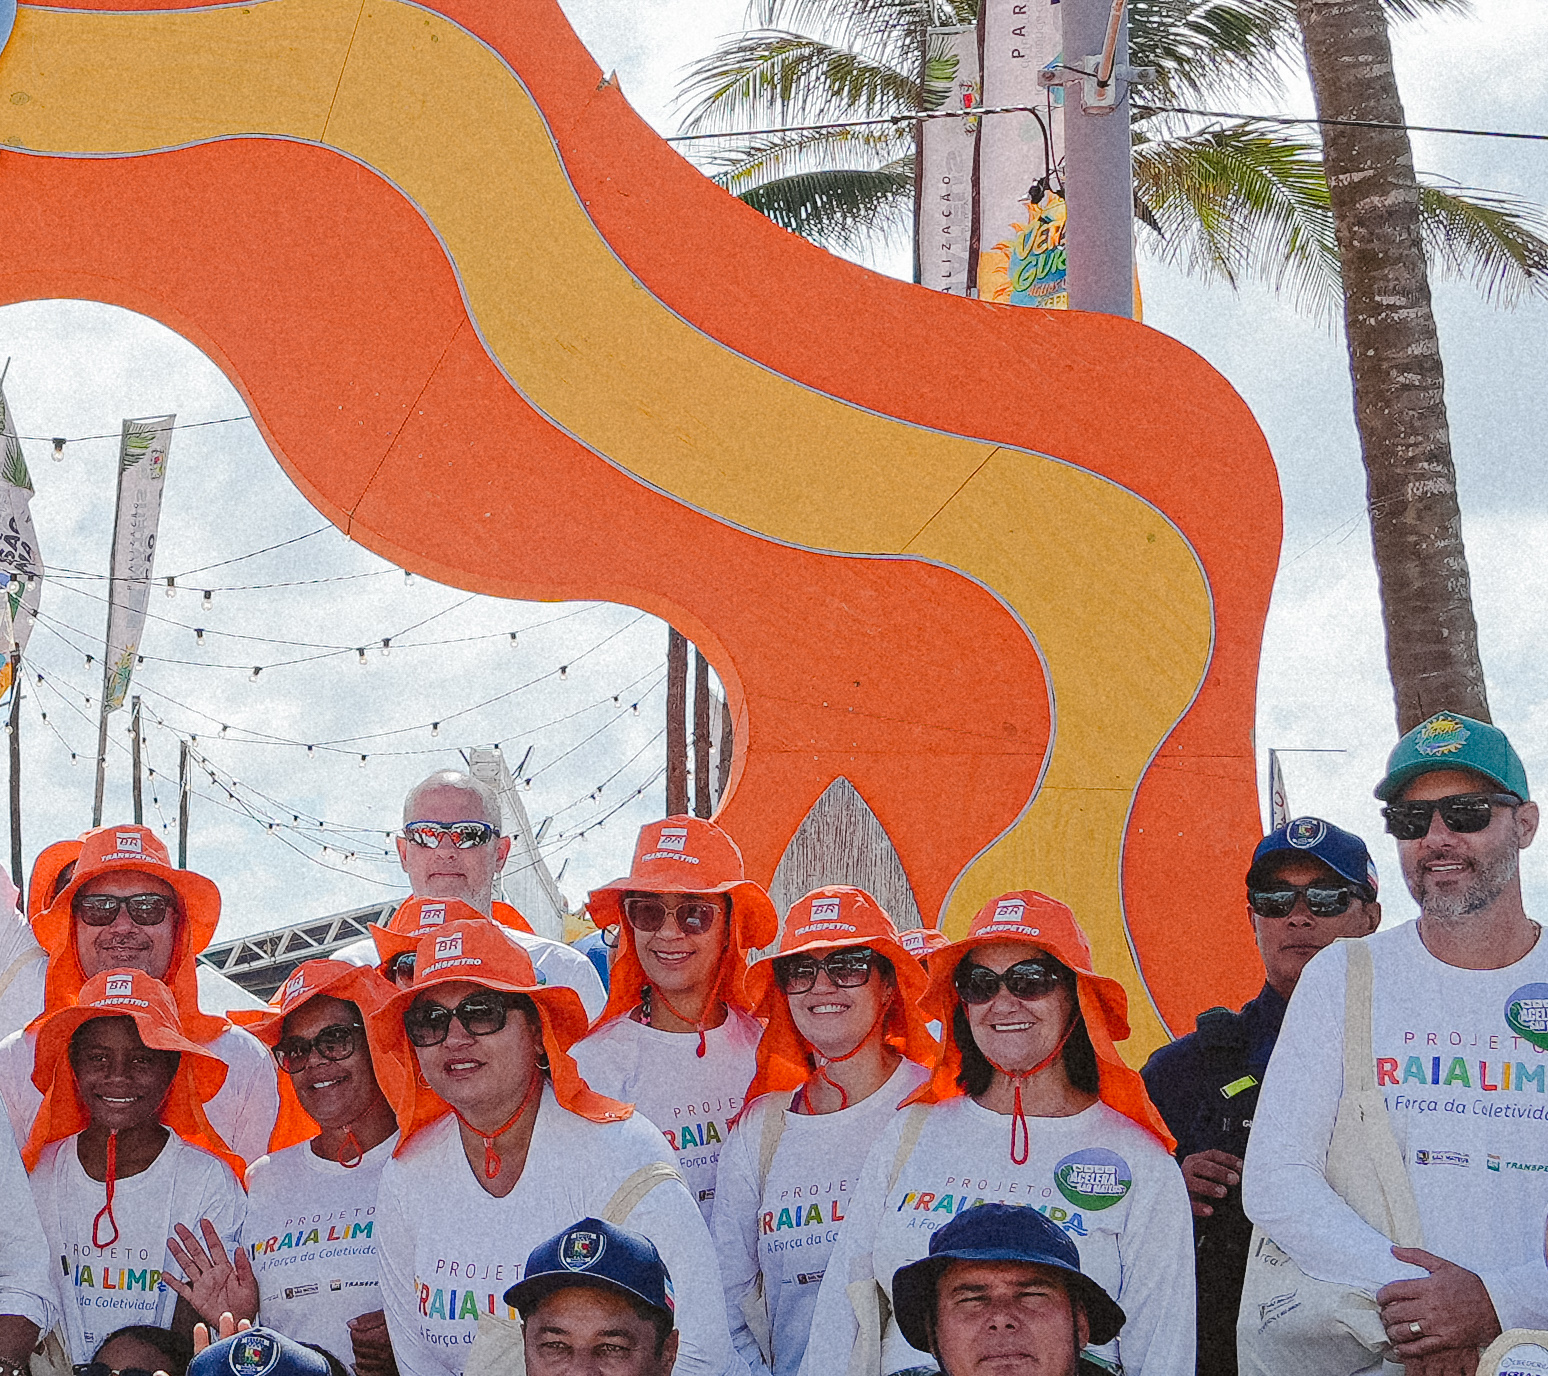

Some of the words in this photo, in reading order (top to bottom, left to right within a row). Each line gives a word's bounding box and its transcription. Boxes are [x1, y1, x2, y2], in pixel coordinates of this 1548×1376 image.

[641, 853, 699, 865] TRANSPETRO
[975, 925, 1039, 938] TRANSPETRO
[421, 959, 482, 975] TRANSPETRO
[1396, 1096, 1439, 1115] Força
[1444, 1096, 1468, 1115] da
[945, 1175, 1053, 1197] PROJETO
[285, 1205, 376, 1227] PROJETO
[251, 1229, 320, 1262] PRAIA
[271, 1254, 298, 1272] Força
